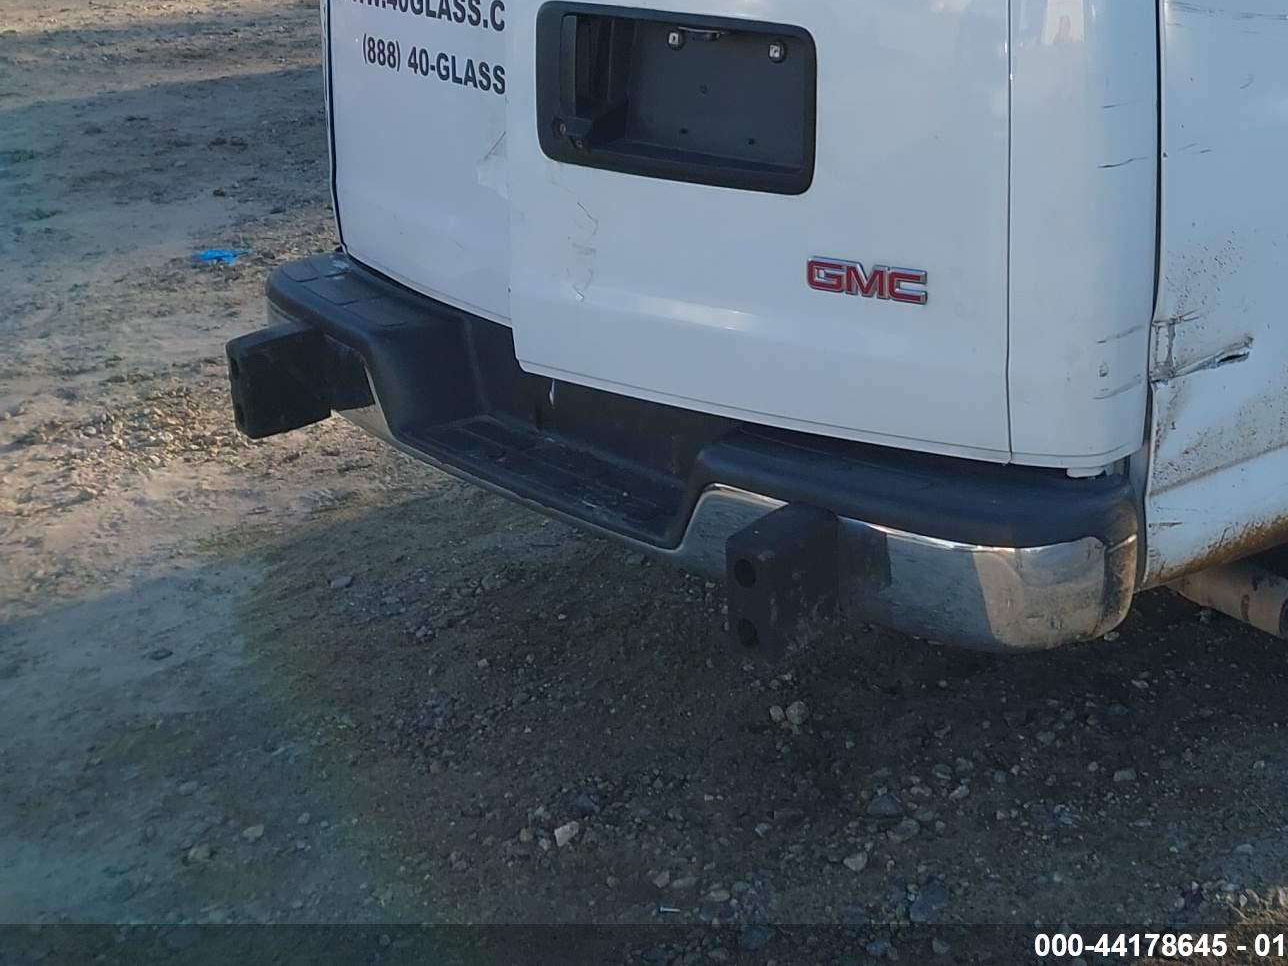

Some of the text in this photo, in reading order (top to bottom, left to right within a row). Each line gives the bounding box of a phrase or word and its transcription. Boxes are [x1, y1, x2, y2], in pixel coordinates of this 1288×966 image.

[362, 33, 506, 95] (888) 40-GLASS
[807, 256, 928, 305] GMC
